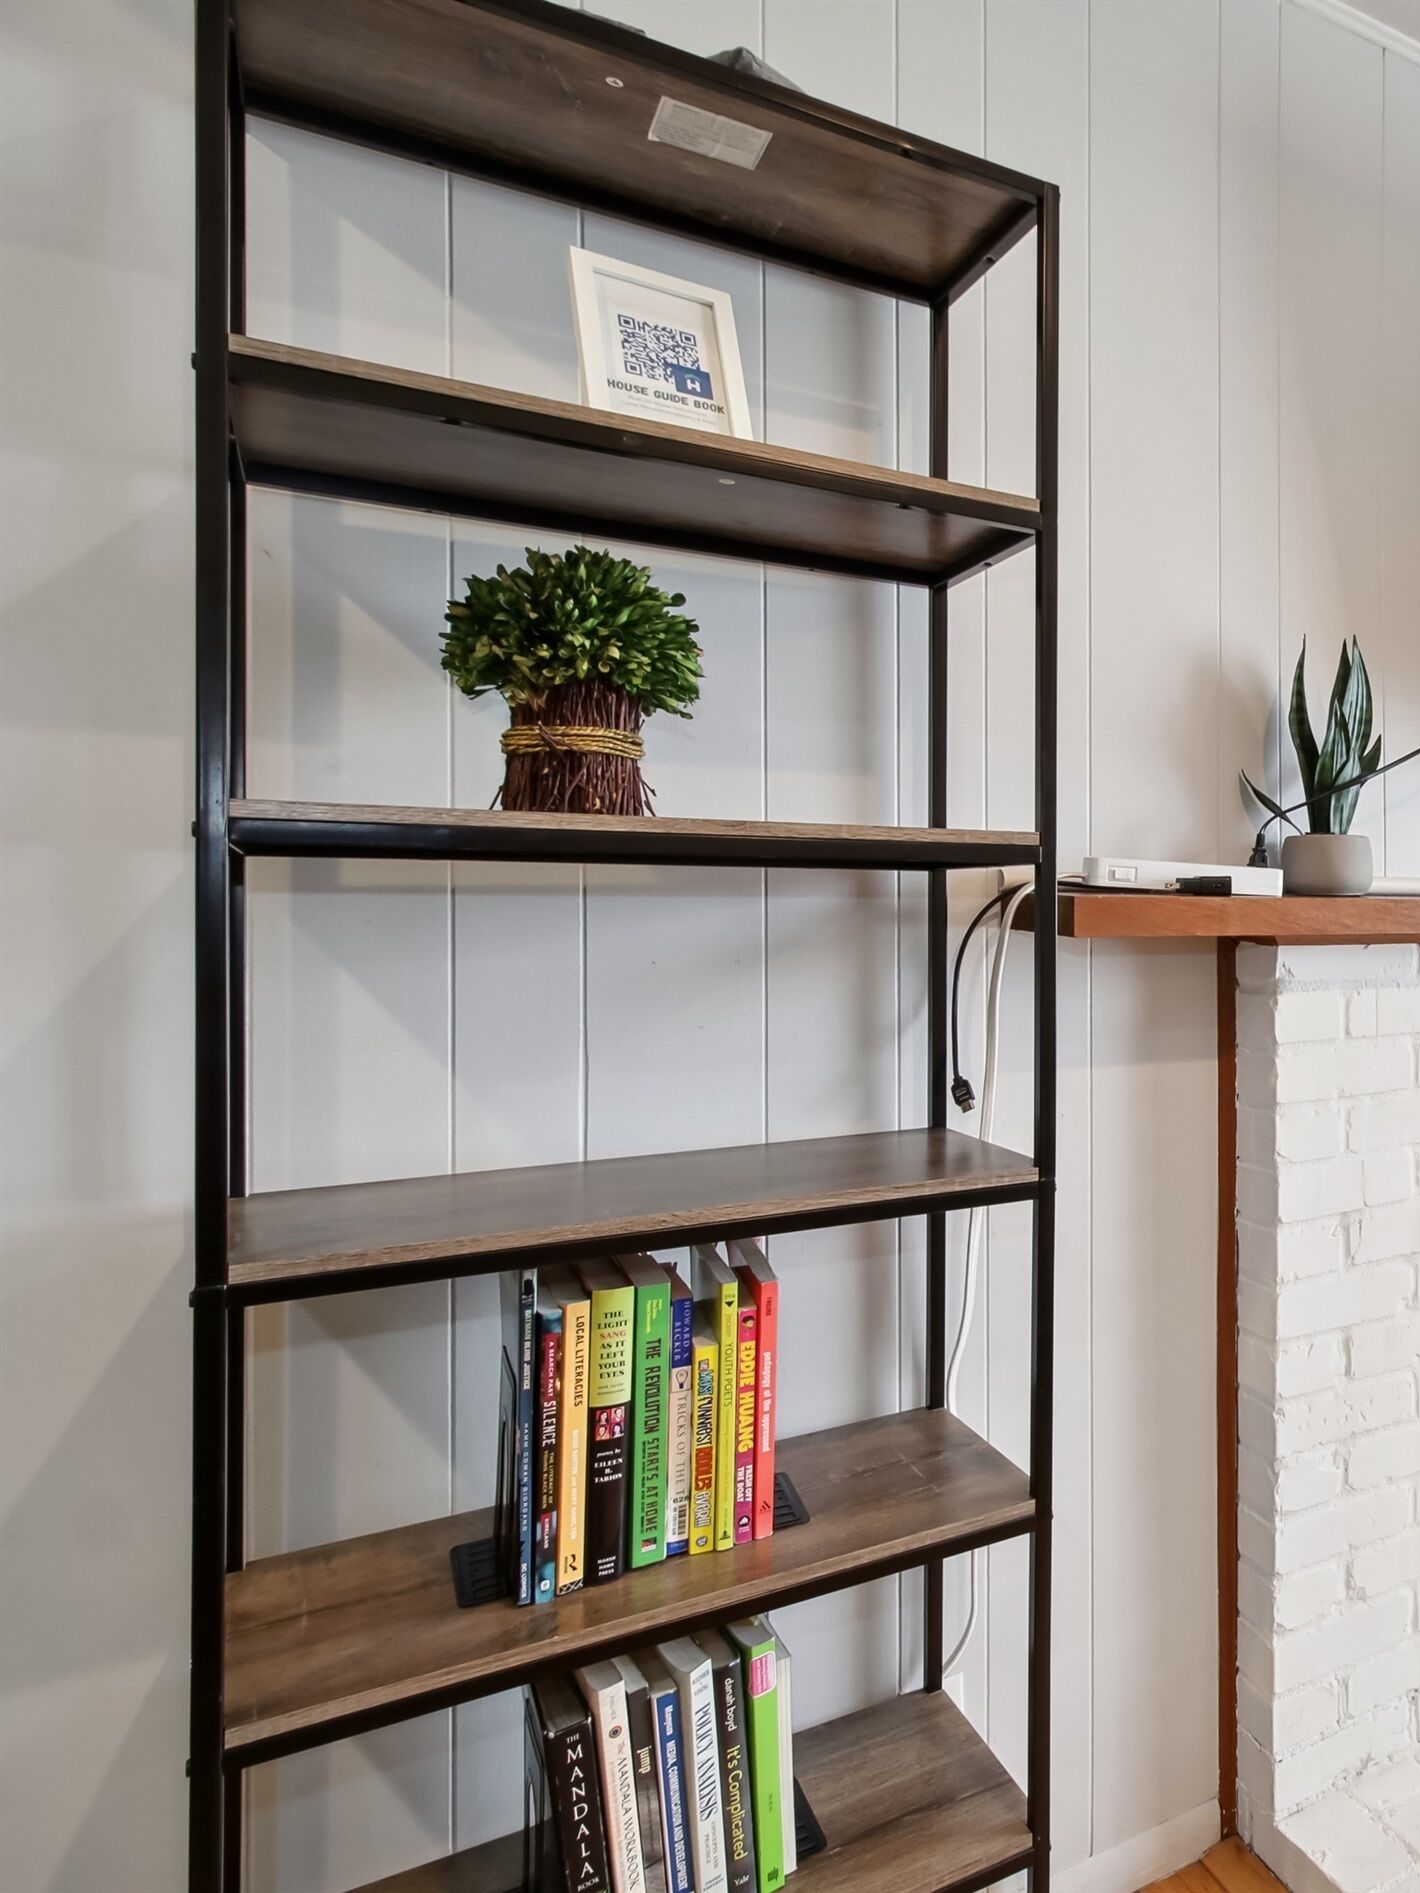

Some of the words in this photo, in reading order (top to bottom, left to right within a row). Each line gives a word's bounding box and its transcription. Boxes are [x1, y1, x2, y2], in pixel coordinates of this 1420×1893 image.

[607, 378, 649, 396] HOUSE
[653, 389, 689, 406] GUIDE
[693, 400, 726, 415] BOOK
[597, 1320, 629, 1330] LIGHT
[603, 1310, 624, 1320] THE
[682, 1301, 691, 1347] HOWARD
[575, 1316, 585, 1349] LOCAL
[600, 1330, 626, 1340] SANG
[600, 1341, 613, 1350] AS
[615, 1340, 625, 1348] IT
[600, 1350, 625, 1360] LEFT
[646, 1338, 662, 1360] THE
[724, 1342, 734, 1376] YOUTH
[740, 1340, 756, 1387] EDDIE
[573, 1350, 584, 1407] LITERACIES
[598, 1360, 626, 1370] YOUR
[600, 1370, 625, 1380] EYES
[762, 1351, 772, 1388] pedagogy
[547, 1379, 555, 1397] PAST
[644, 1365, 661, 1434] REVOLUTION
[723, 1378, 733, 1408] POETS
[676, 1393, 687, 1437] TRICKS
[763, 1399, 771, 1411] the
[542, 1400, 557, 1447] SILENCE
[737, 1390, 755, 1454] HUANG
[761, 1413, 771, 1452] oppressed
[646, 1438, 660, 1481] STARTS
[676, 1439, 686, 1456] OF
[594, 1457, 624, 1468] EILEEN
[675, 1461, 686, 1484] THE
[745, 1464, 753, 1487] FRESH
[646, 1486, 658, 1499] AT
[736, 1481, 744, 1502] BOAT
[745, 1488, 753, 1502] OFF
[645, 1503, 658, 1532] HOME
[724, 1677, 735, 1706] danah
[694, 1702, 714, 1757] POLICY
[726, 1707, 738, 1732] boyd
[566, 1732, 580, 1744] THE
[636, 1745, 652, 1774] jump
[666, 1739, 677, 1769] MEDIA,
[727, 1743, 742, 1769] It's
[617, 1756, 632, 1817] MANDALA
[667, 1766, 682, 1826] COMMUNICATION
[696, 1757, 718, 1822] ANALYSIS
[566, 1744, 594, 1879] MANDALA
[727, 1769, 748, 1861] Complicated
[673, 1826, 683, 1841] AND
[624, 1817, 640, 1891] WORKBOOK
[674, 1841, 688, 1890] DEVELOPMENT
[577, 1876, 600, 1893] BOOK
[734, 1873, 750, 1887] Yale
